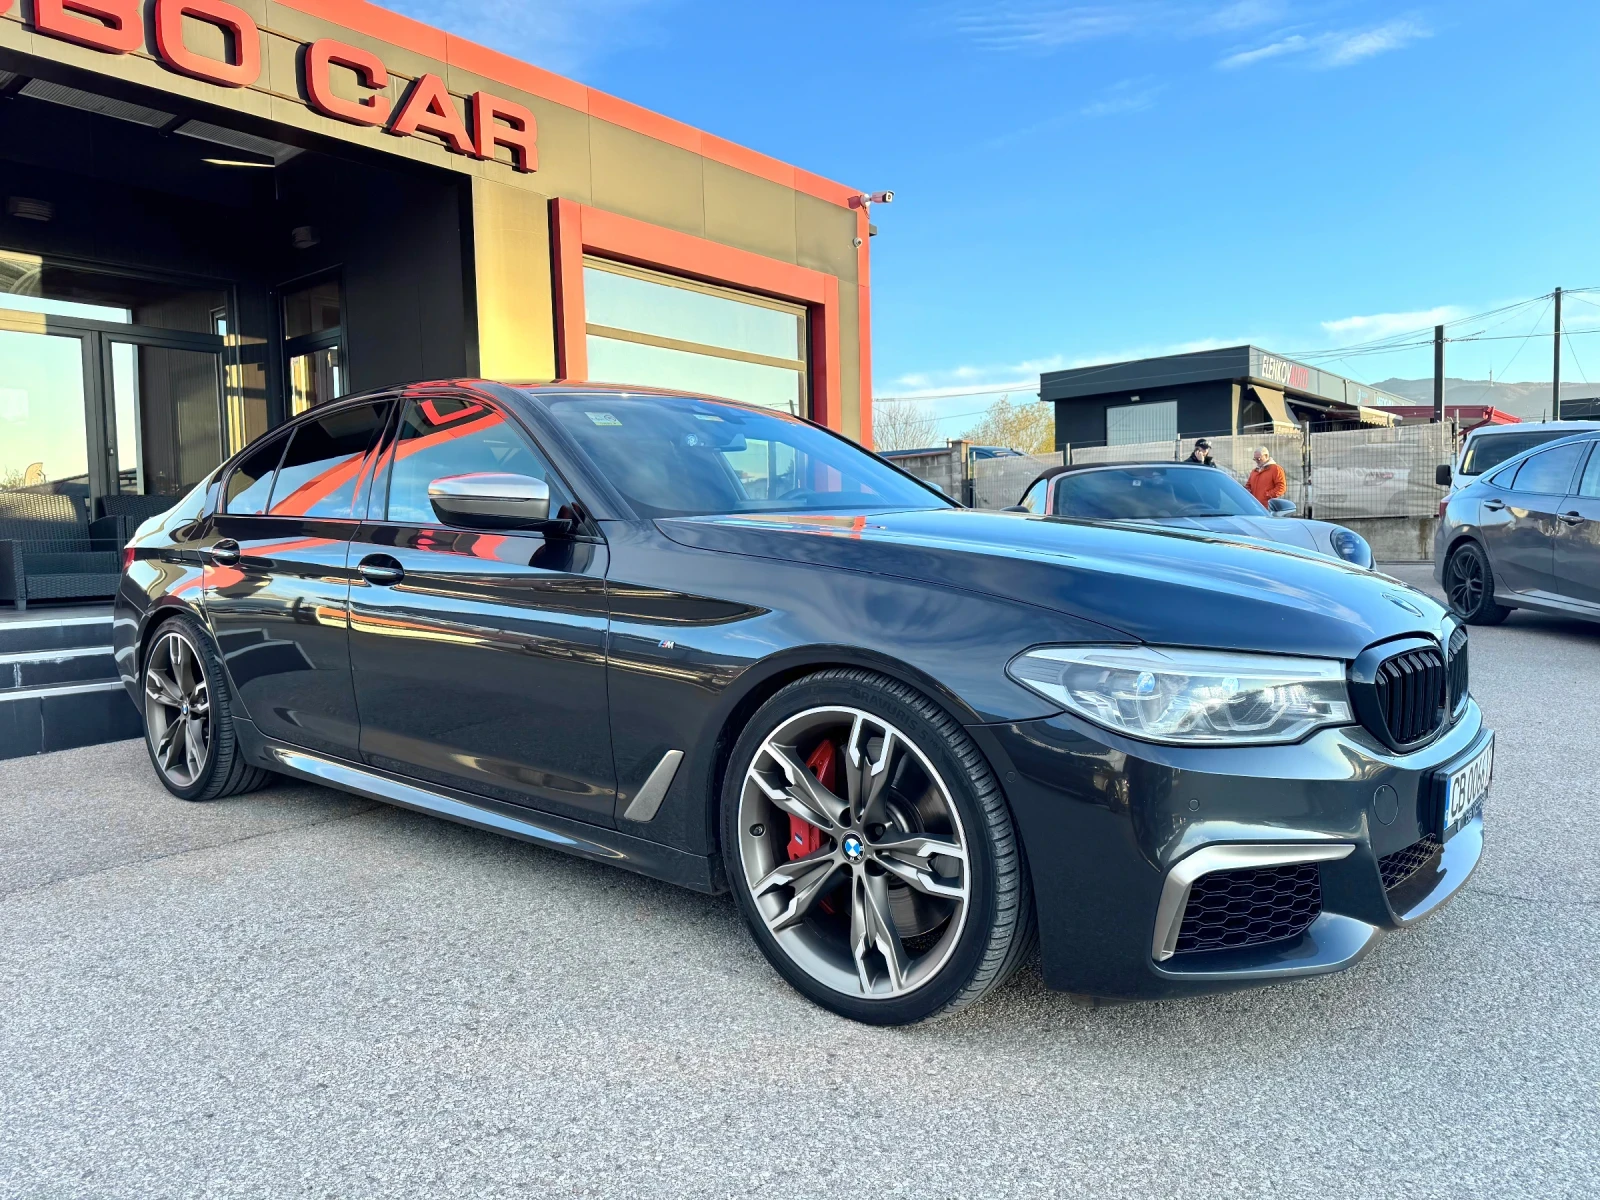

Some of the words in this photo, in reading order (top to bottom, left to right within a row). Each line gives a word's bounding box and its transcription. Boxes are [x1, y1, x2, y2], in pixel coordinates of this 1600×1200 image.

[304, 38, 538, 174] CAR
[851, 686, 918, 731] BRAVURIS
[1450, 772, 1467, 818] CB
